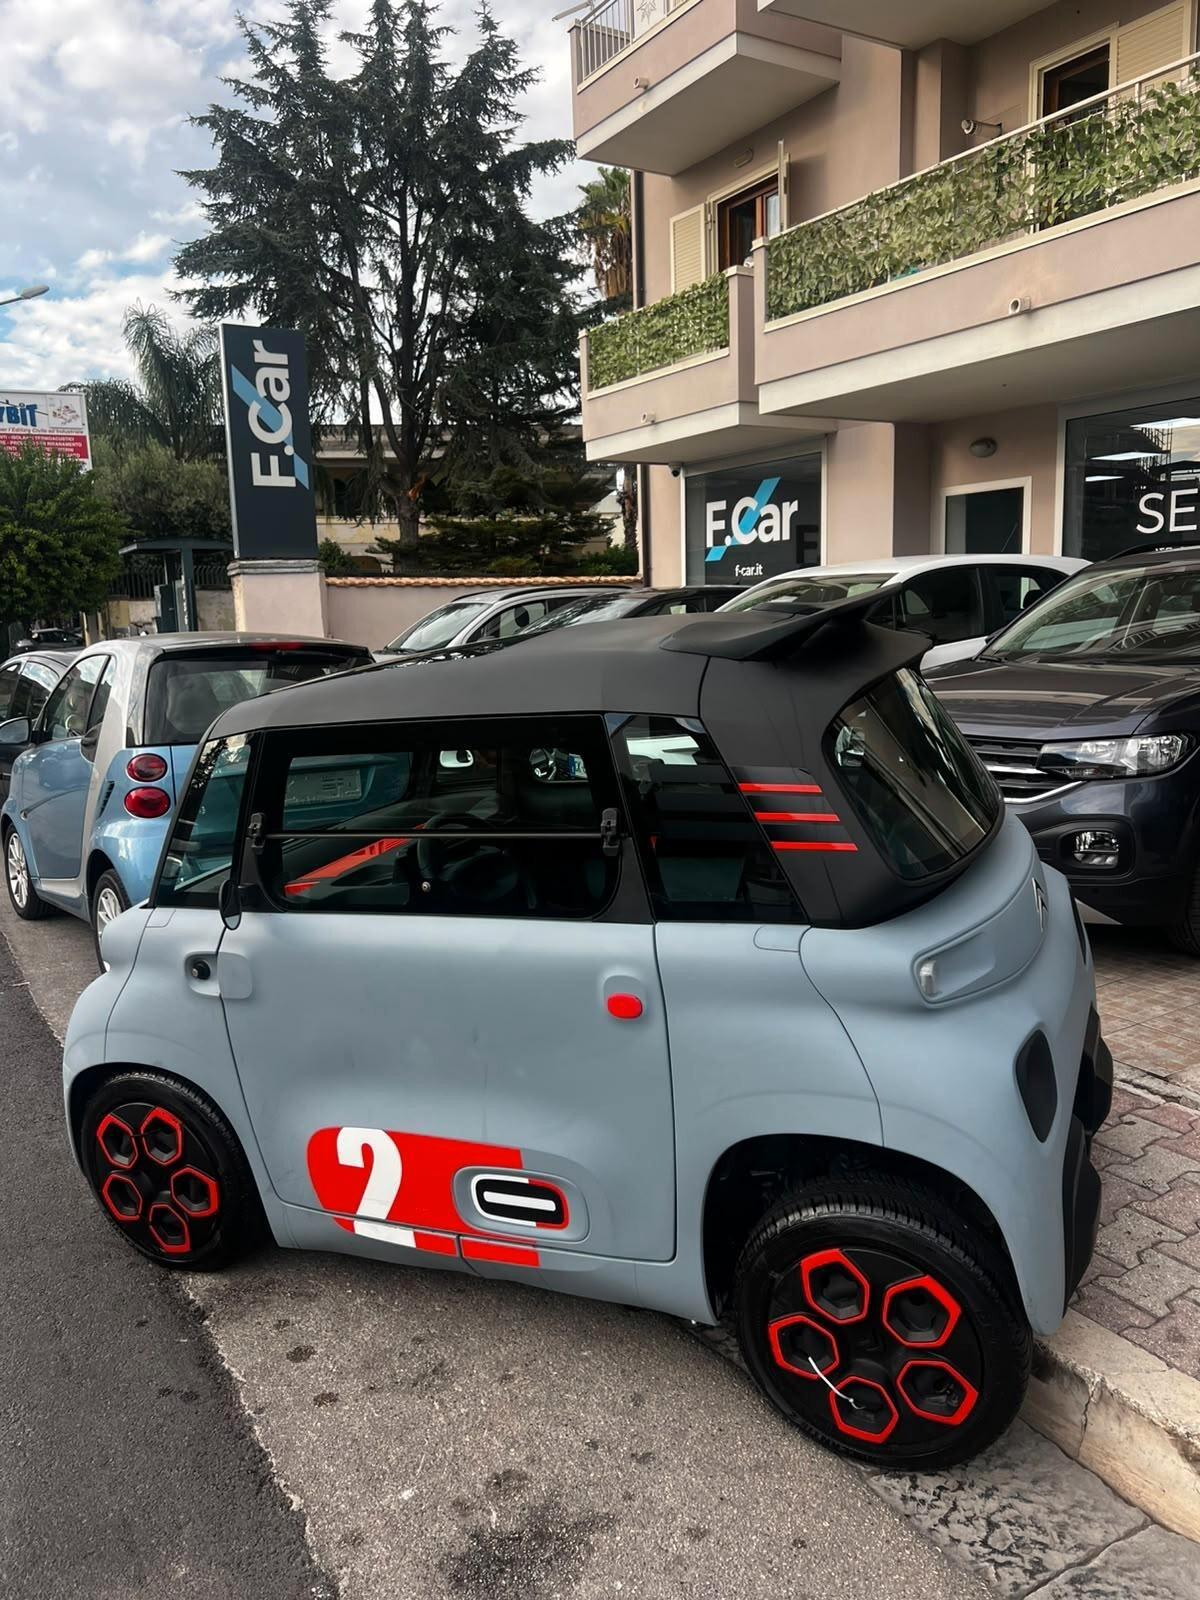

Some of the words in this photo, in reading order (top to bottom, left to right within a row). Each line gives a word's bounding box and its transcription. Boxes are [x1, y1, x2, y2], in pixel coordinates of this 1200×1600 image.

[248, 339, 296, 488] F.Car
[706, 496, 799, 548] F.Car
[1136, 488, 1199, 534] SE
[735, 563, 763, 577] f-car.it
